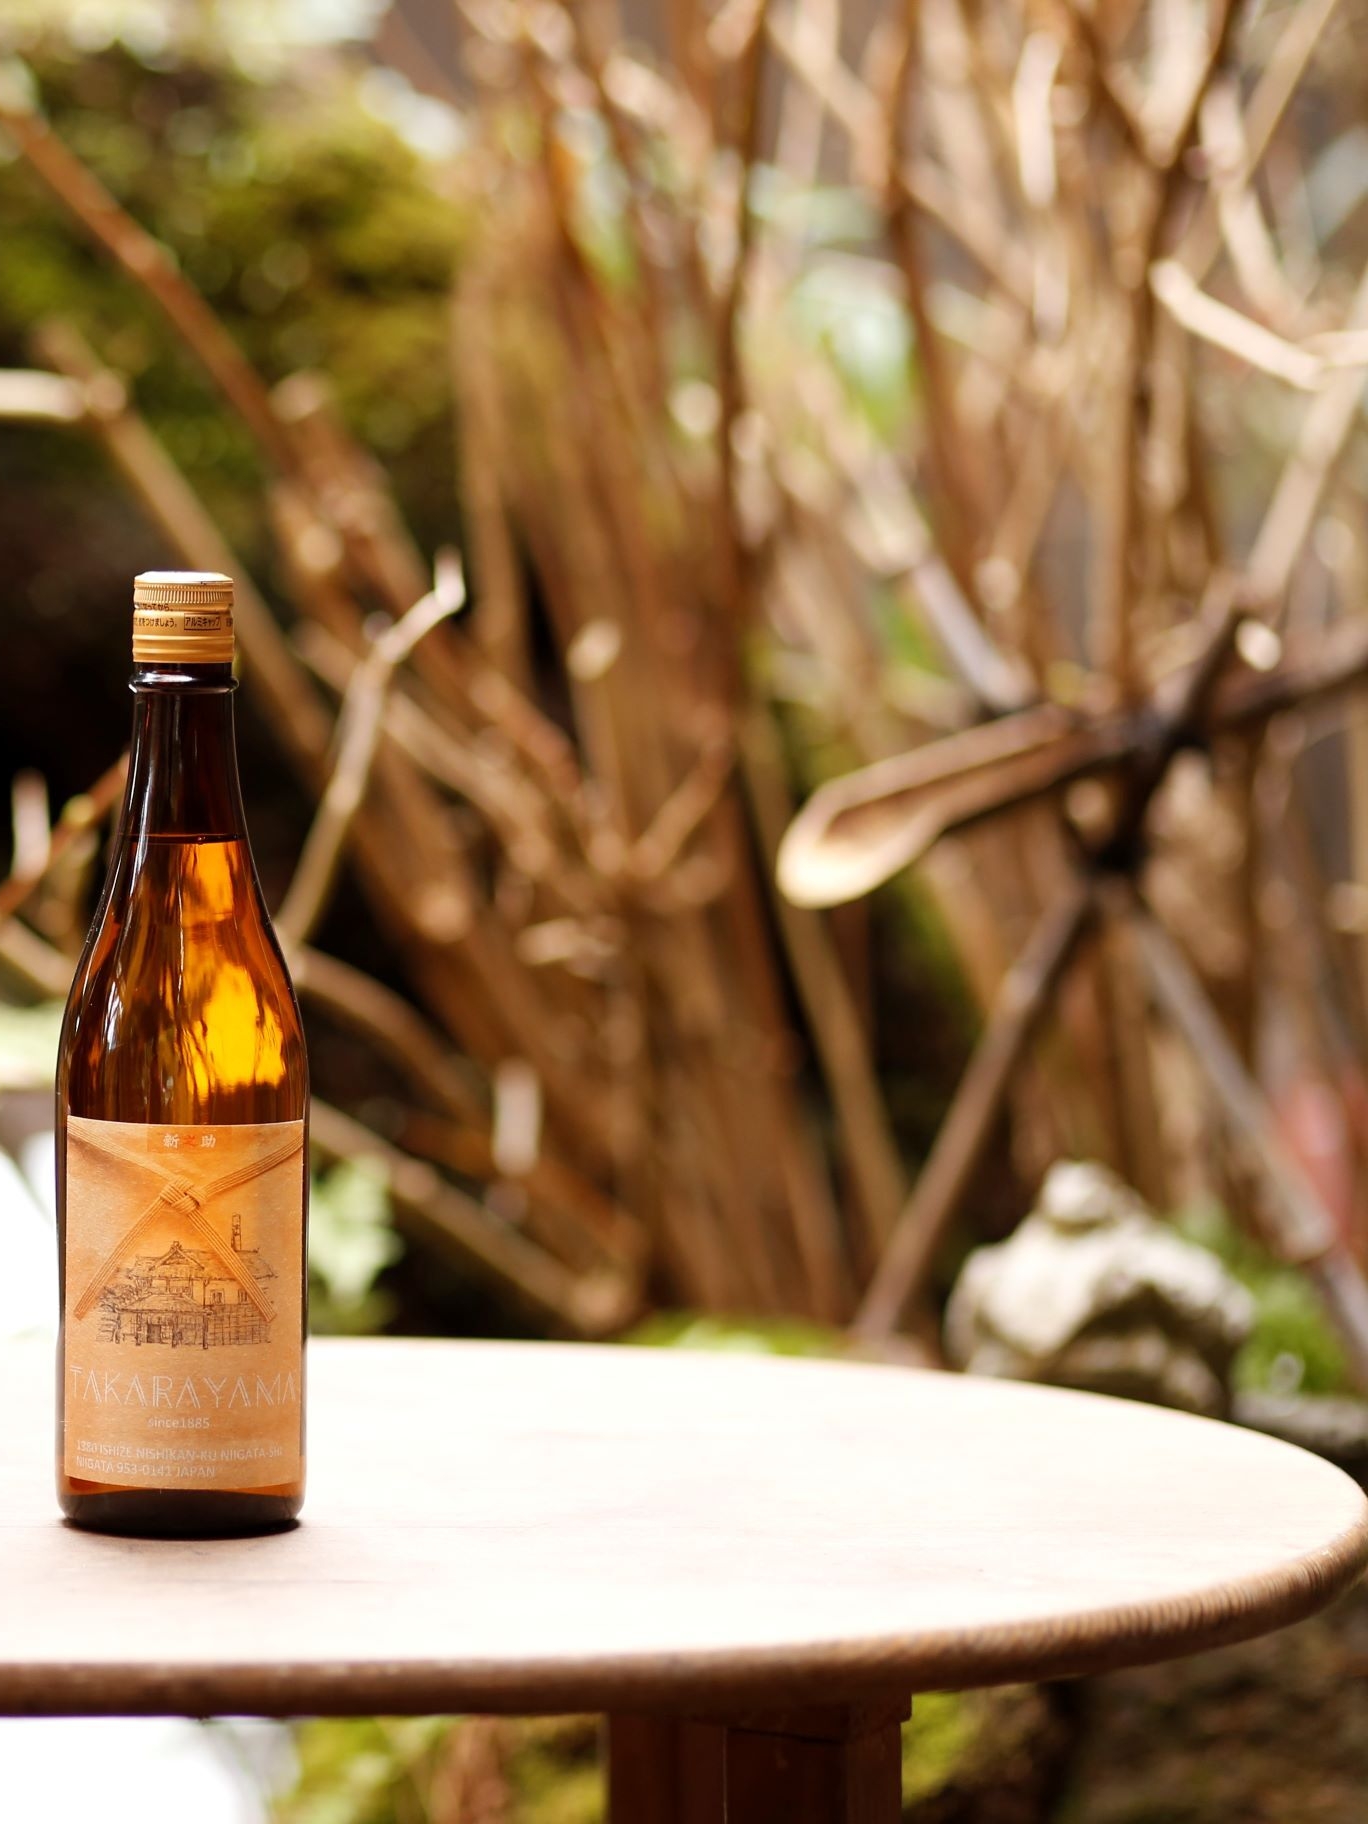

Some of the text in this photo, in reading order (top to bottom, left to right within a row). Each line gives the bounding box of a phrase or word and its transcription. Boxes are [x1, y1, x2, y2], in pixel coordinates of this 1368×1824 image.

[163, 1133, 217, 1149] 新之助
[69, 1364, 297, 1409] TAKARAYAMA
[176, 1466, 216, 1478] JAPAN
